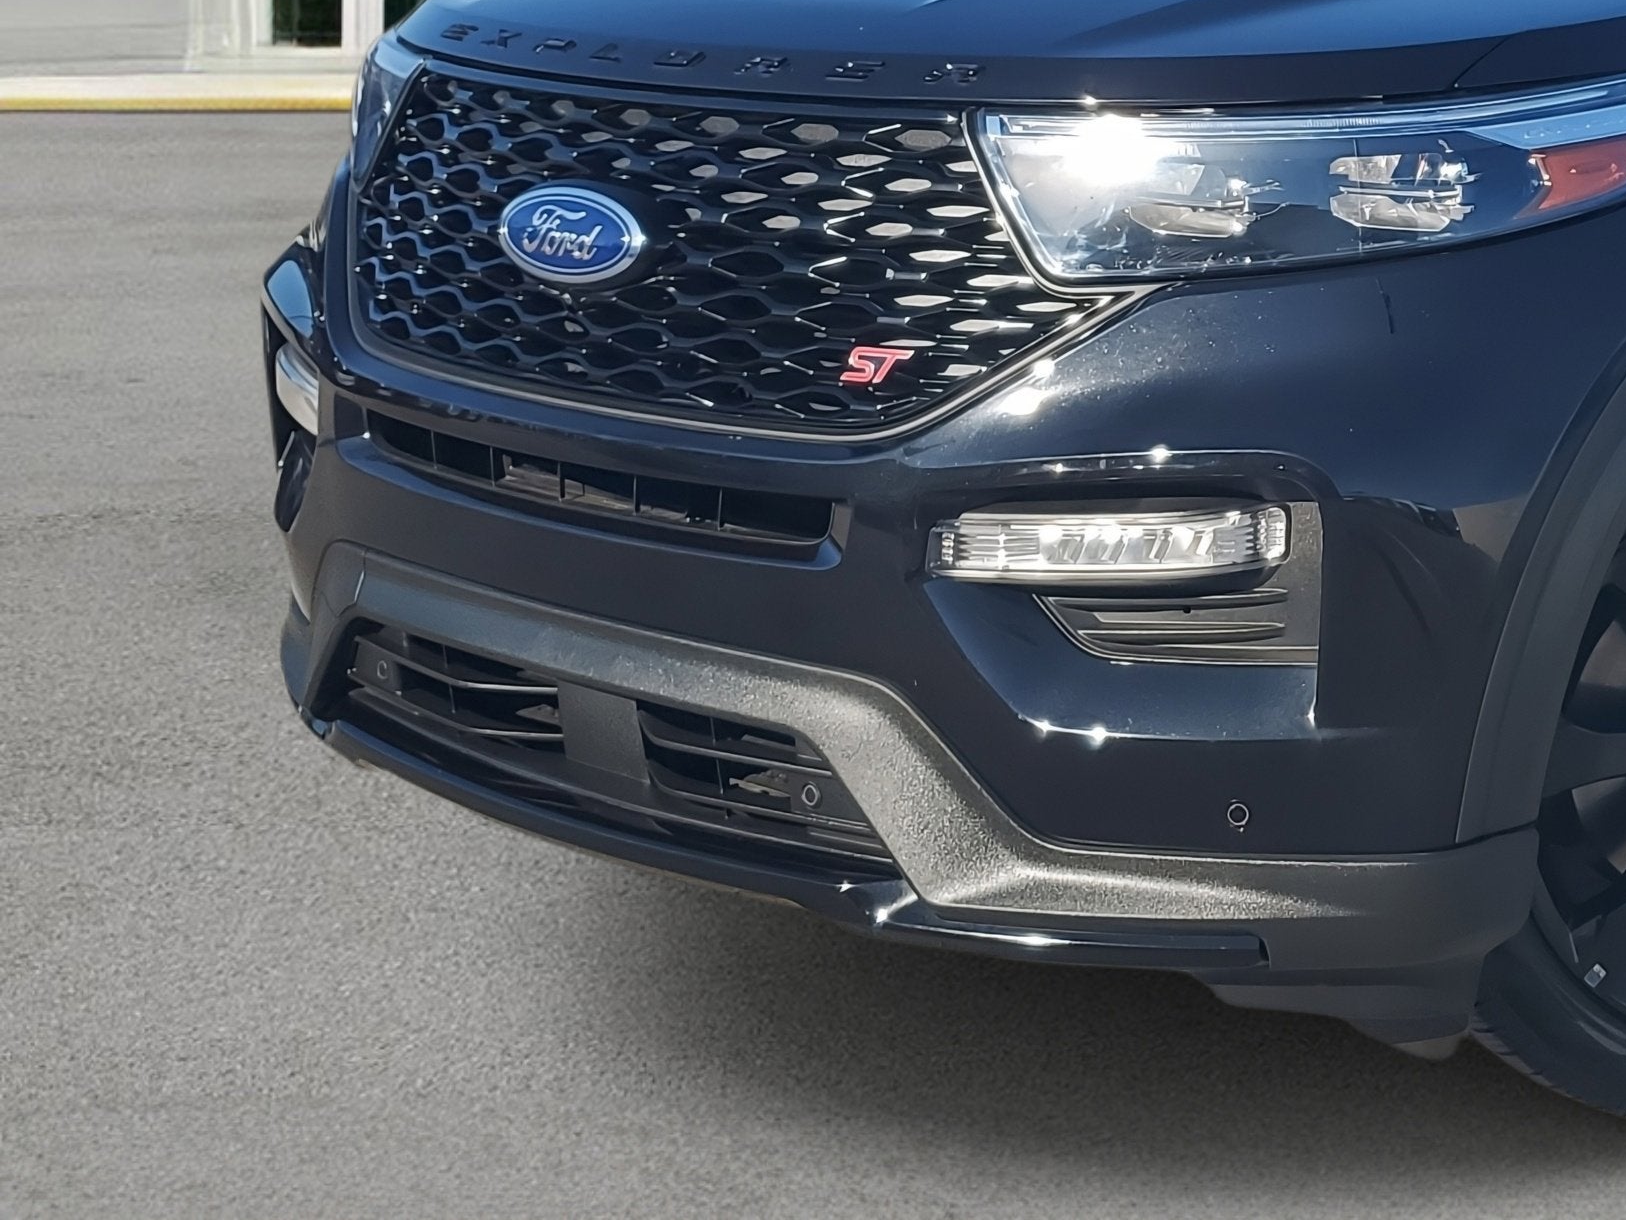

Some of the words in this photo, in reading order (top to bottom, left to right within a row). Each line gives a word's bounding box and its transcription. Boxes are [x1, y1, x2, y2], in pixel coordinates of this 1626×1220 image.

[440, 23, 986, 84] EXPLORER
[521, 204, 603, 262] Ford
[839, 346, 916, 385] ST
